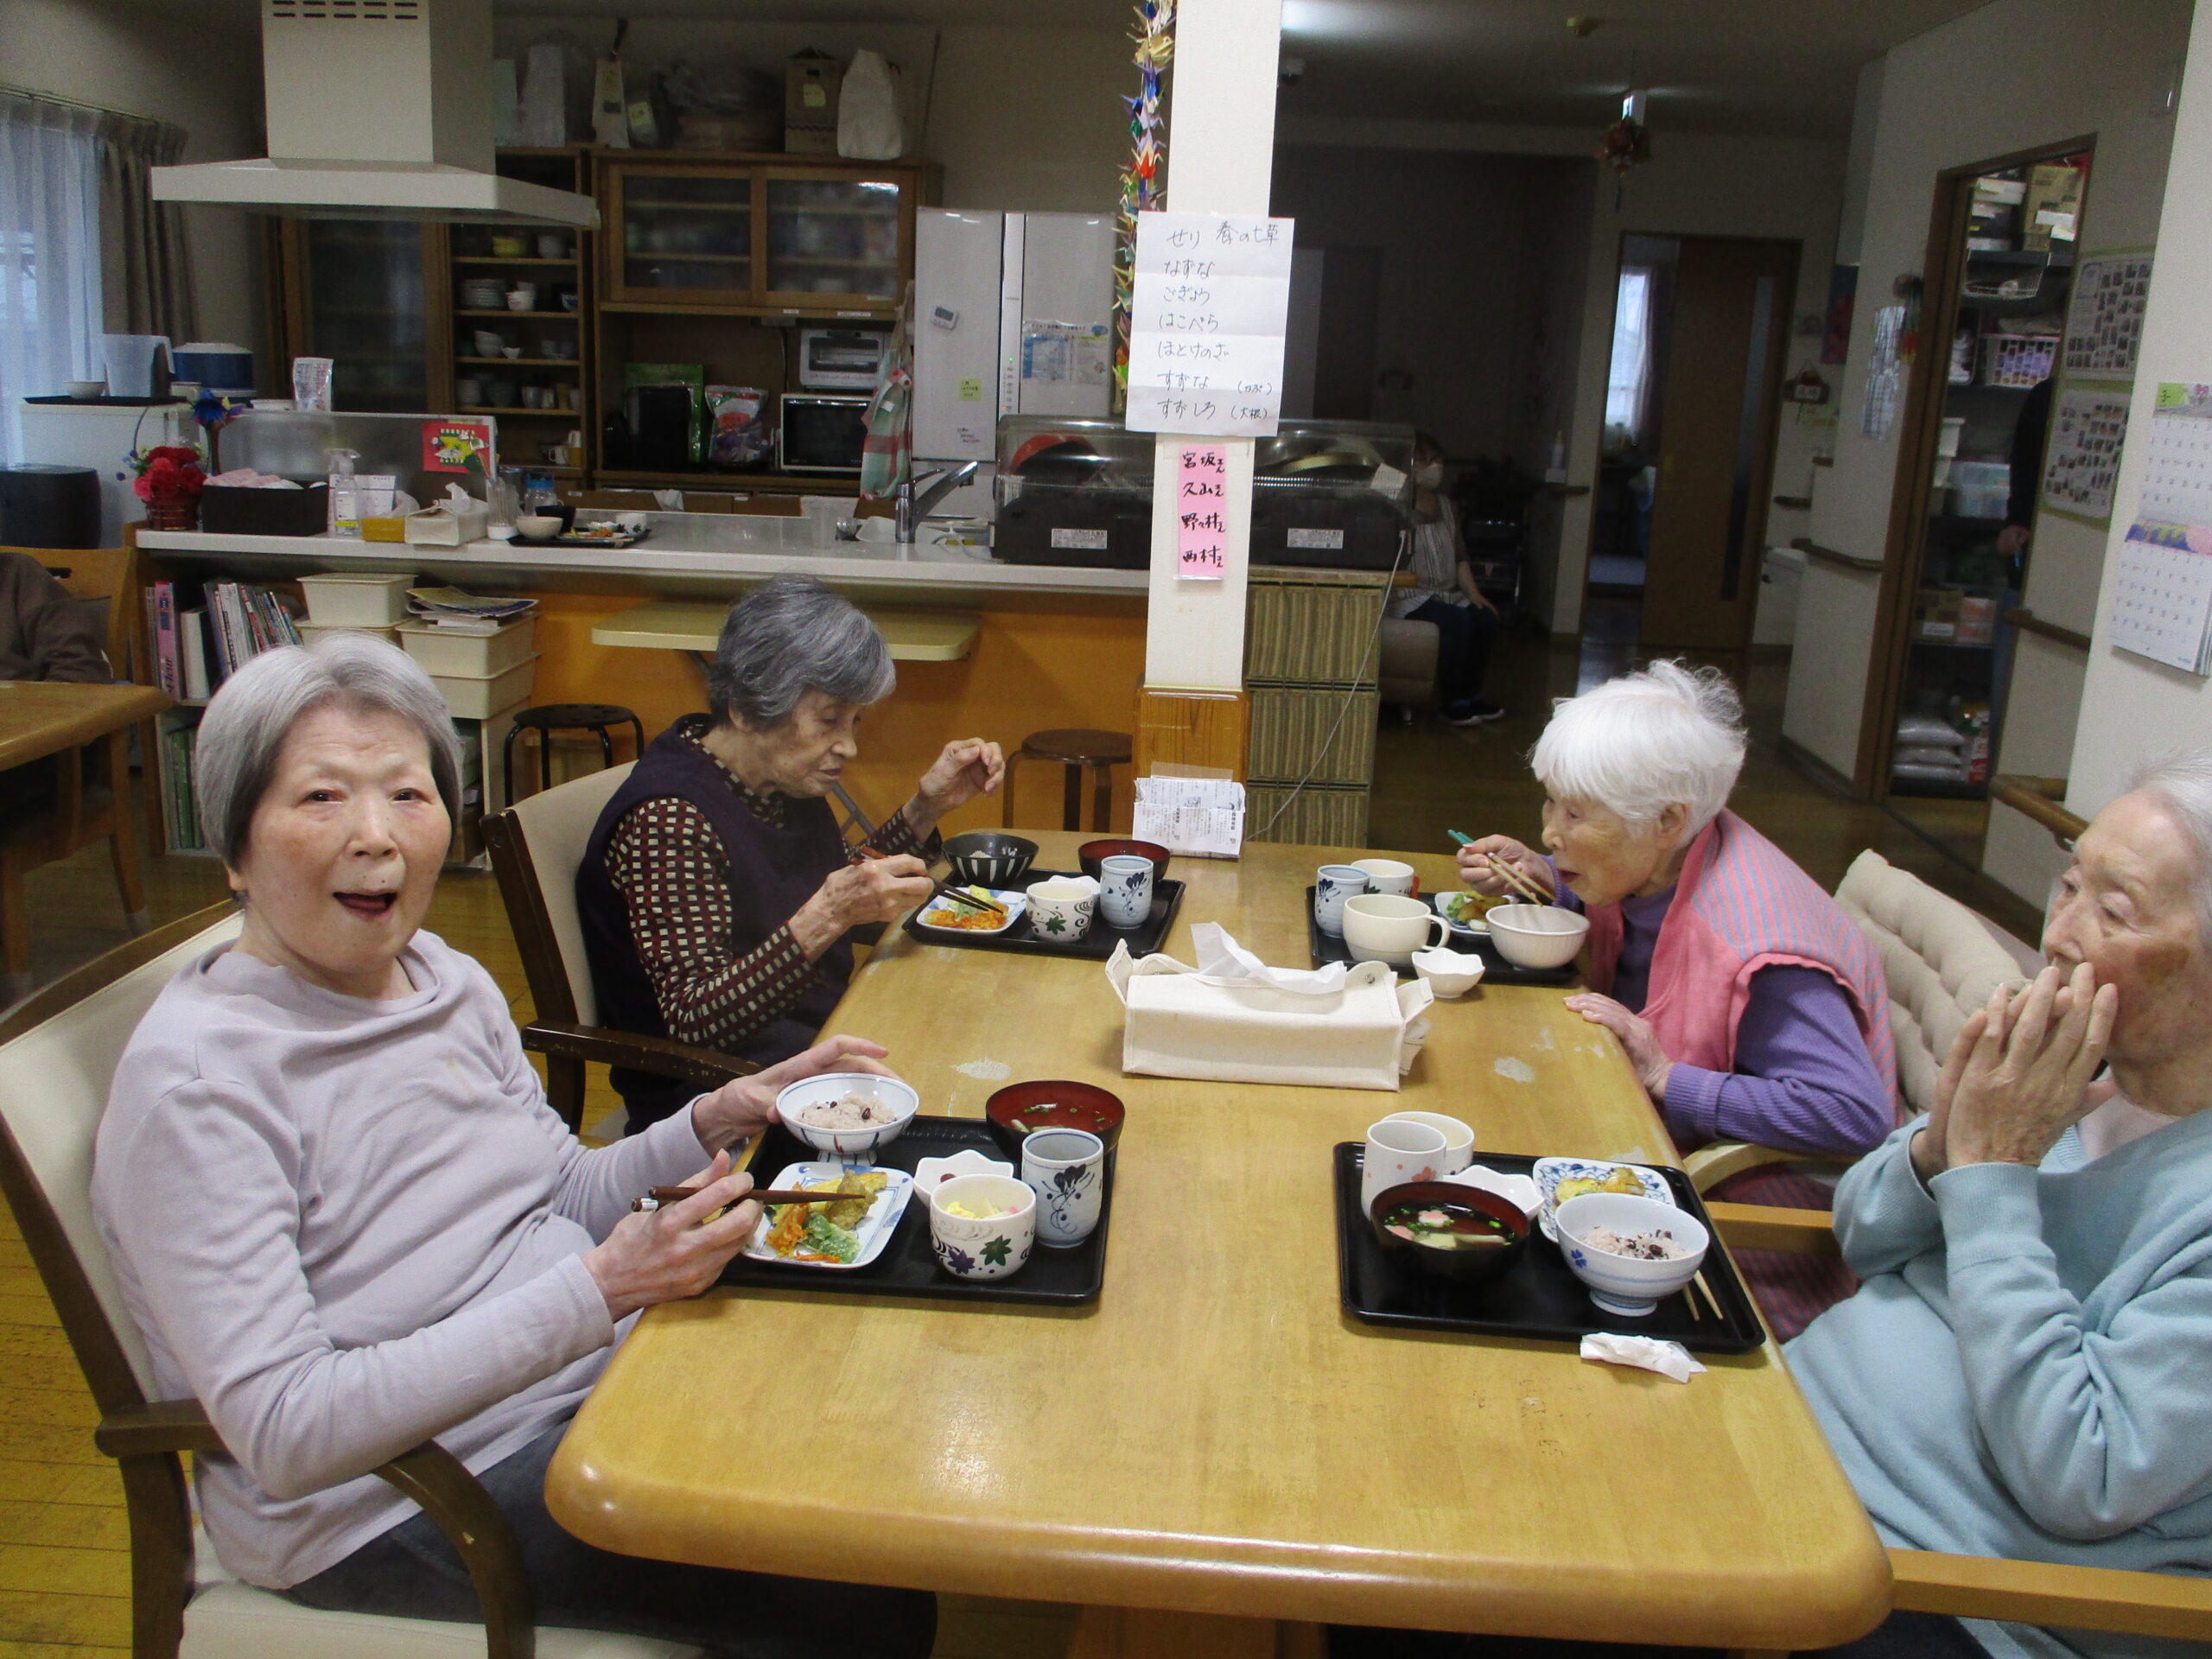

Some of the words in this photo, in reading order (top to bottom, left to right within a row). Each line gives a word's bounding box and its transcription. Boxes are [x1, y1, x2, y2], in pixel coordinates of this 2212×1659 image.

[1166, 230, 1199, 248] せり
[1216, 220, 1279, 247] 春の七草
[1164, 259, 1214, 280] なずな
[1158, 341, 1229, 361] ほとけのざ
[1157, 370, 1208, 391] すずな
[1157, 398, 1216, 420] すずしろ
